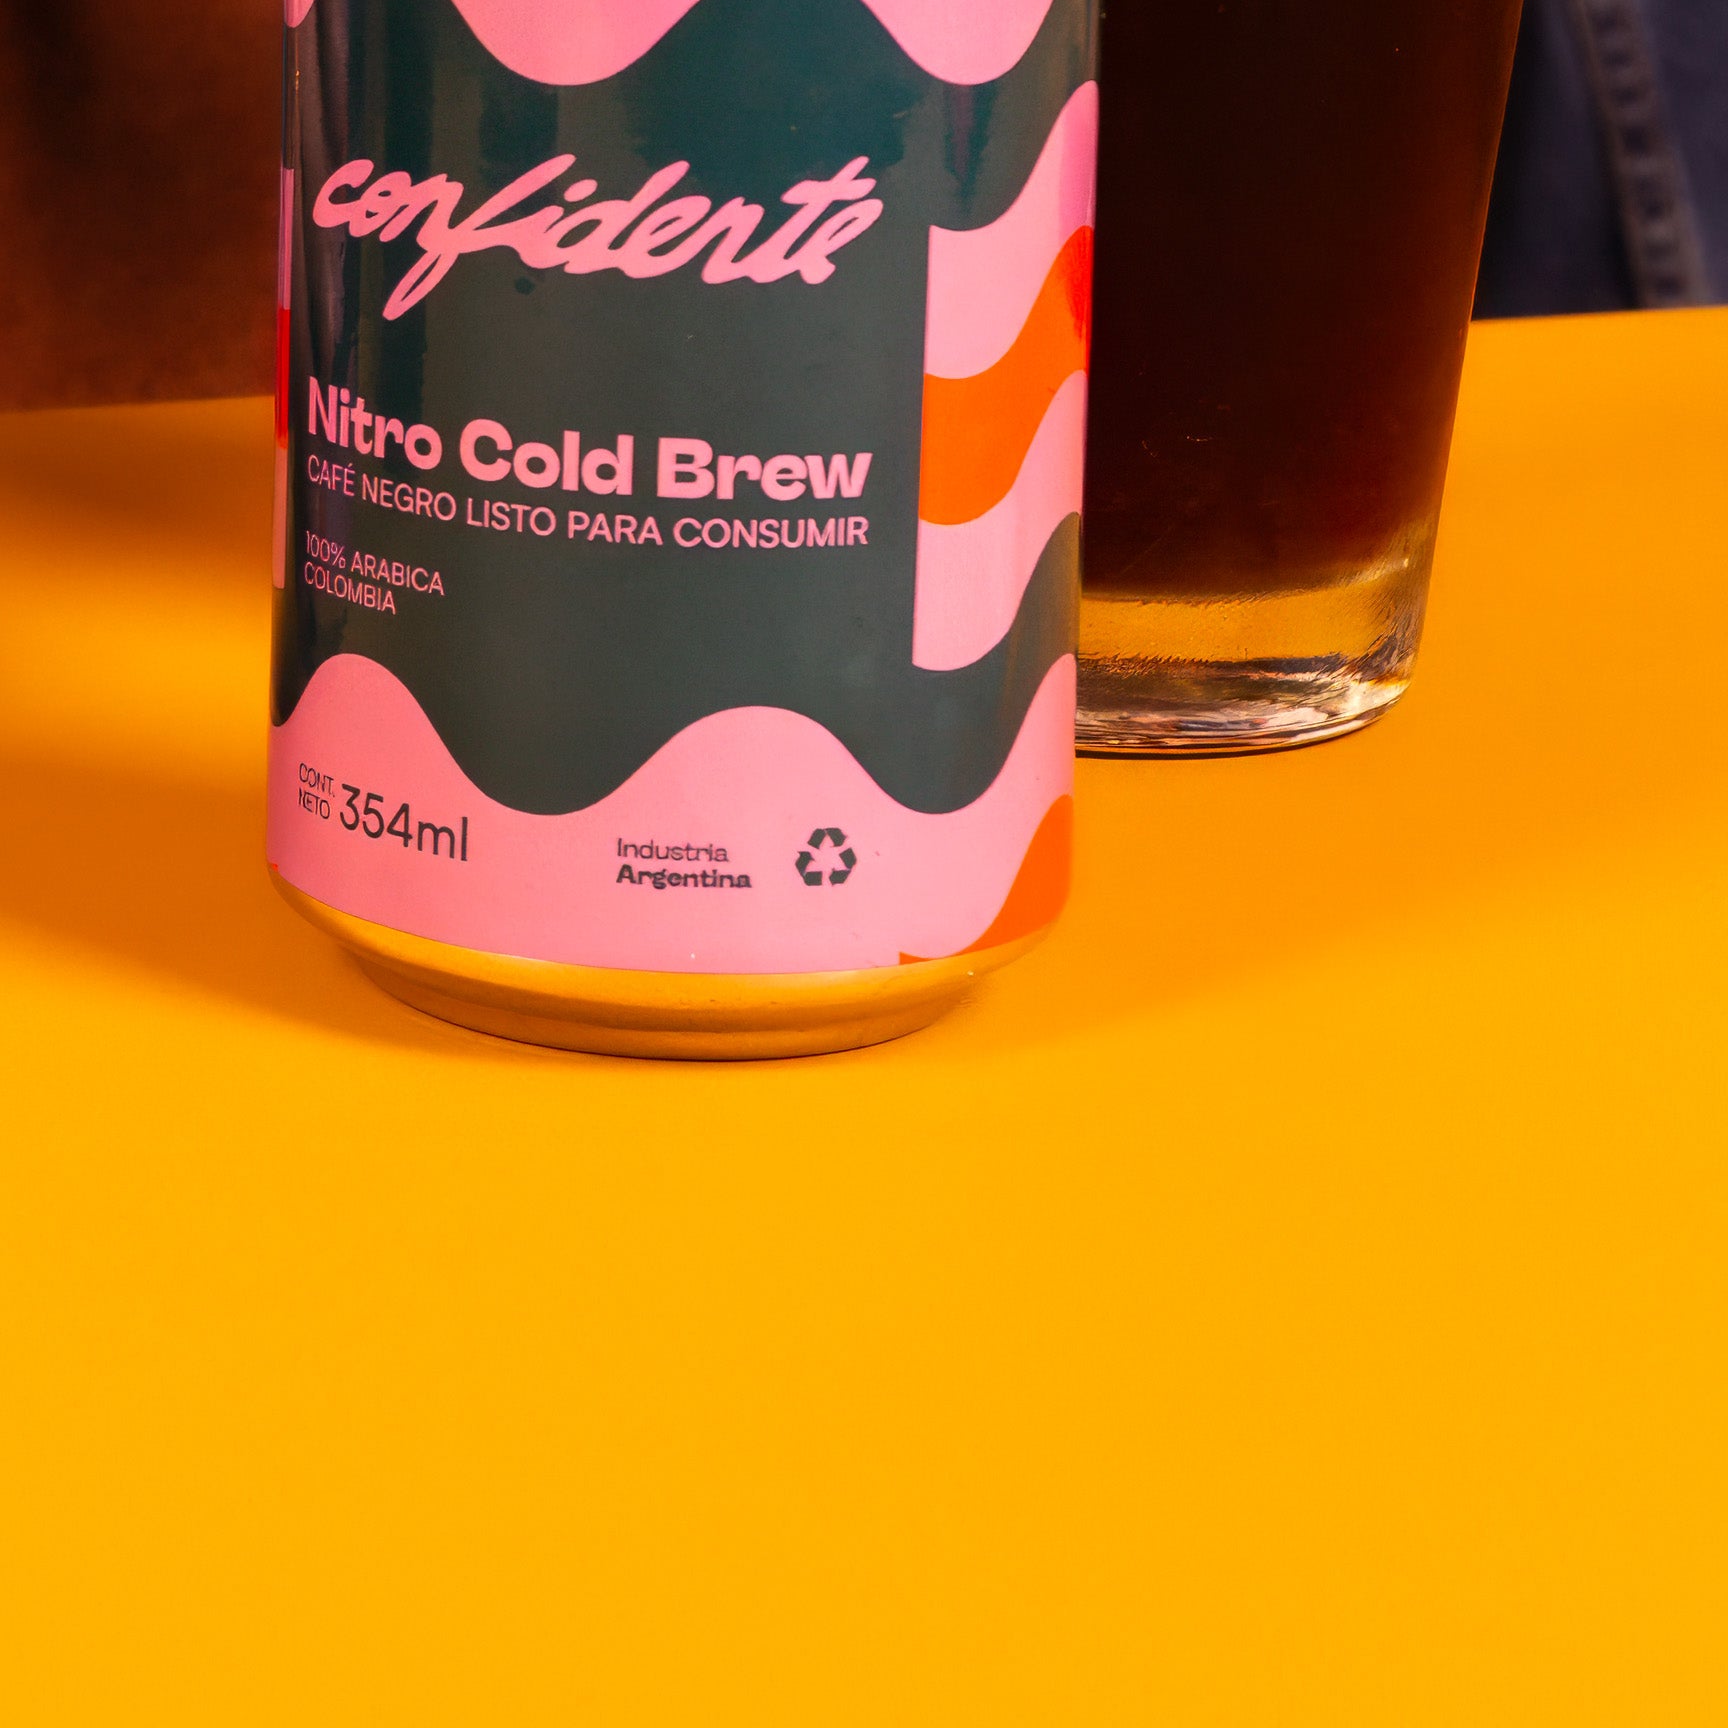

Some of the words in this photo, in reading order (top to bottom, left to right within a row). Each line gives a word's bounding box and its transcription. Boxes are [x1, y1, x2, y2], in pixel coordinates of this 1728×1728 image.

[312, 153, 883, 320] confidente
[307, 376, 442, 470] Nitro
[459, 419, 632, 496] Cold
[656, 438, 873, 501] Brew
[307, 455, 355, 497] CAFÉ
[362, 475, 457, 522] NEGRO
[466, 497, 556, 536] LISTO
[566, 512, 663, 545] PARA
[672, 516, 869, 549] CONSUMIR
[304, 561, 396, 615] COLOMBIA
[305, 530, 346, 569] 100%
[350, 551, 445, 596] ARABICA
[339, 783, 468, 862] 354ml
[617, 838, 729, 863] Industria
[616, 863, 752, 890] Argentina
